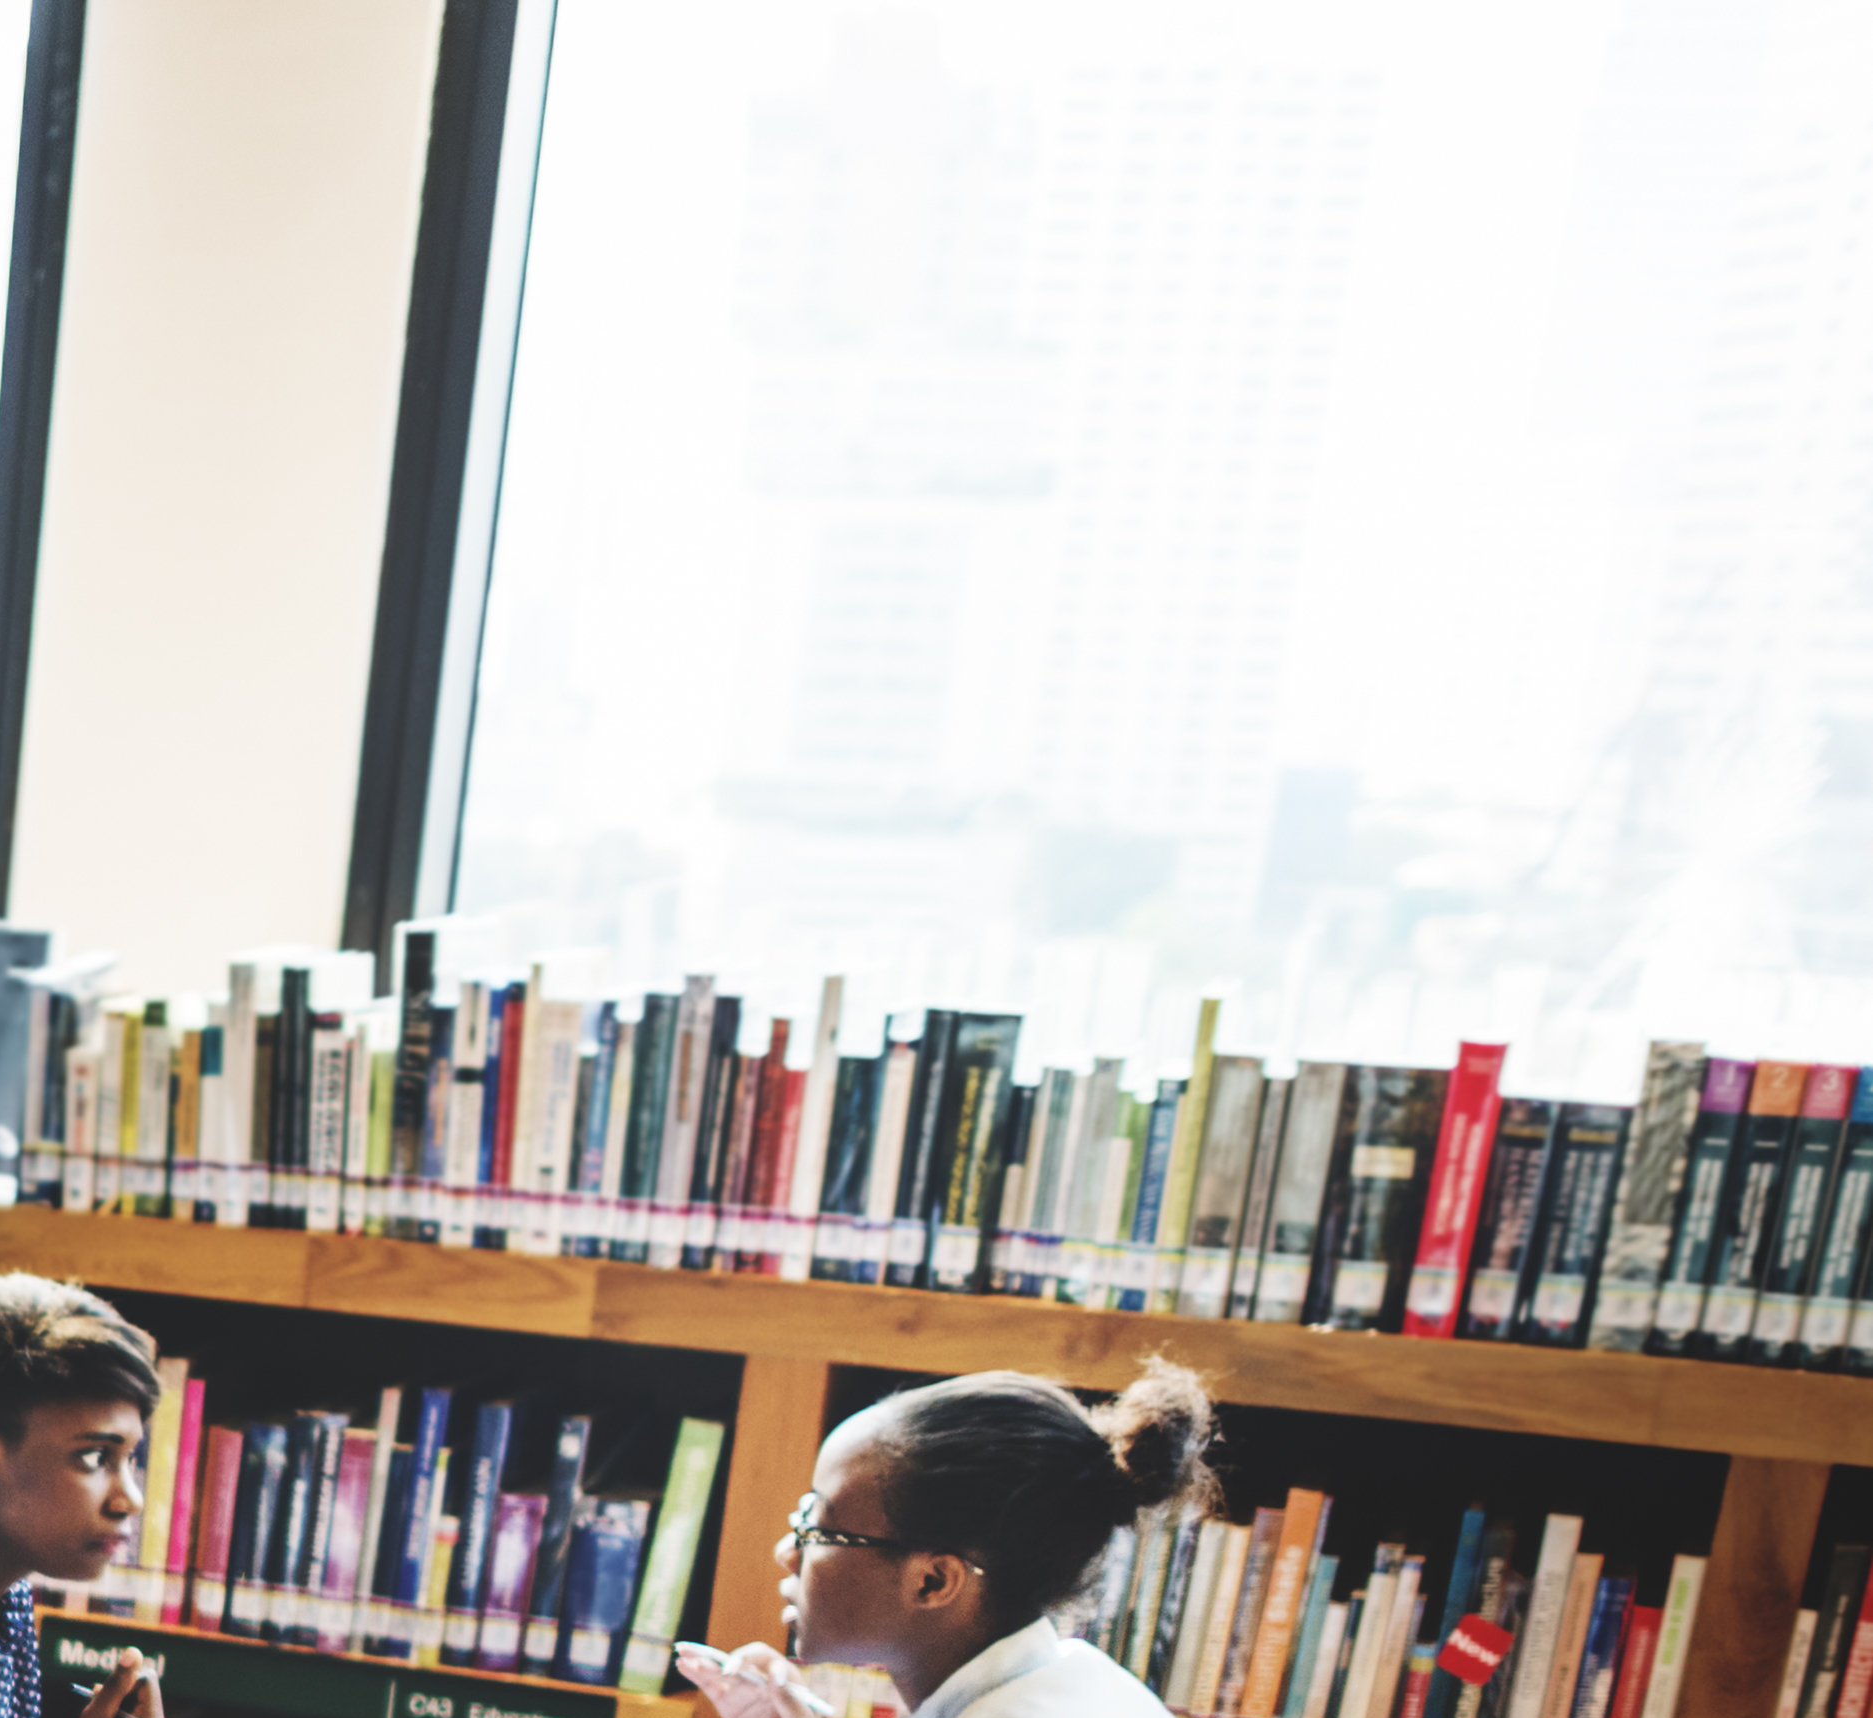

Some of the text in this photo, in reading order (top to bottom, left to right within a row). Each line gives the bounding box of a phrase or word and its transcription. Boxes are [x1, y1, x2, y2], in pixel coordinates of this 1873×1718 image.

[1769, 1066, 1791, 1089] 2
[1819, 1068, 1840, 1093] 3
[59, 1638, 166, 1678] Medal
[1447, 1628, 1503, 1670] New
